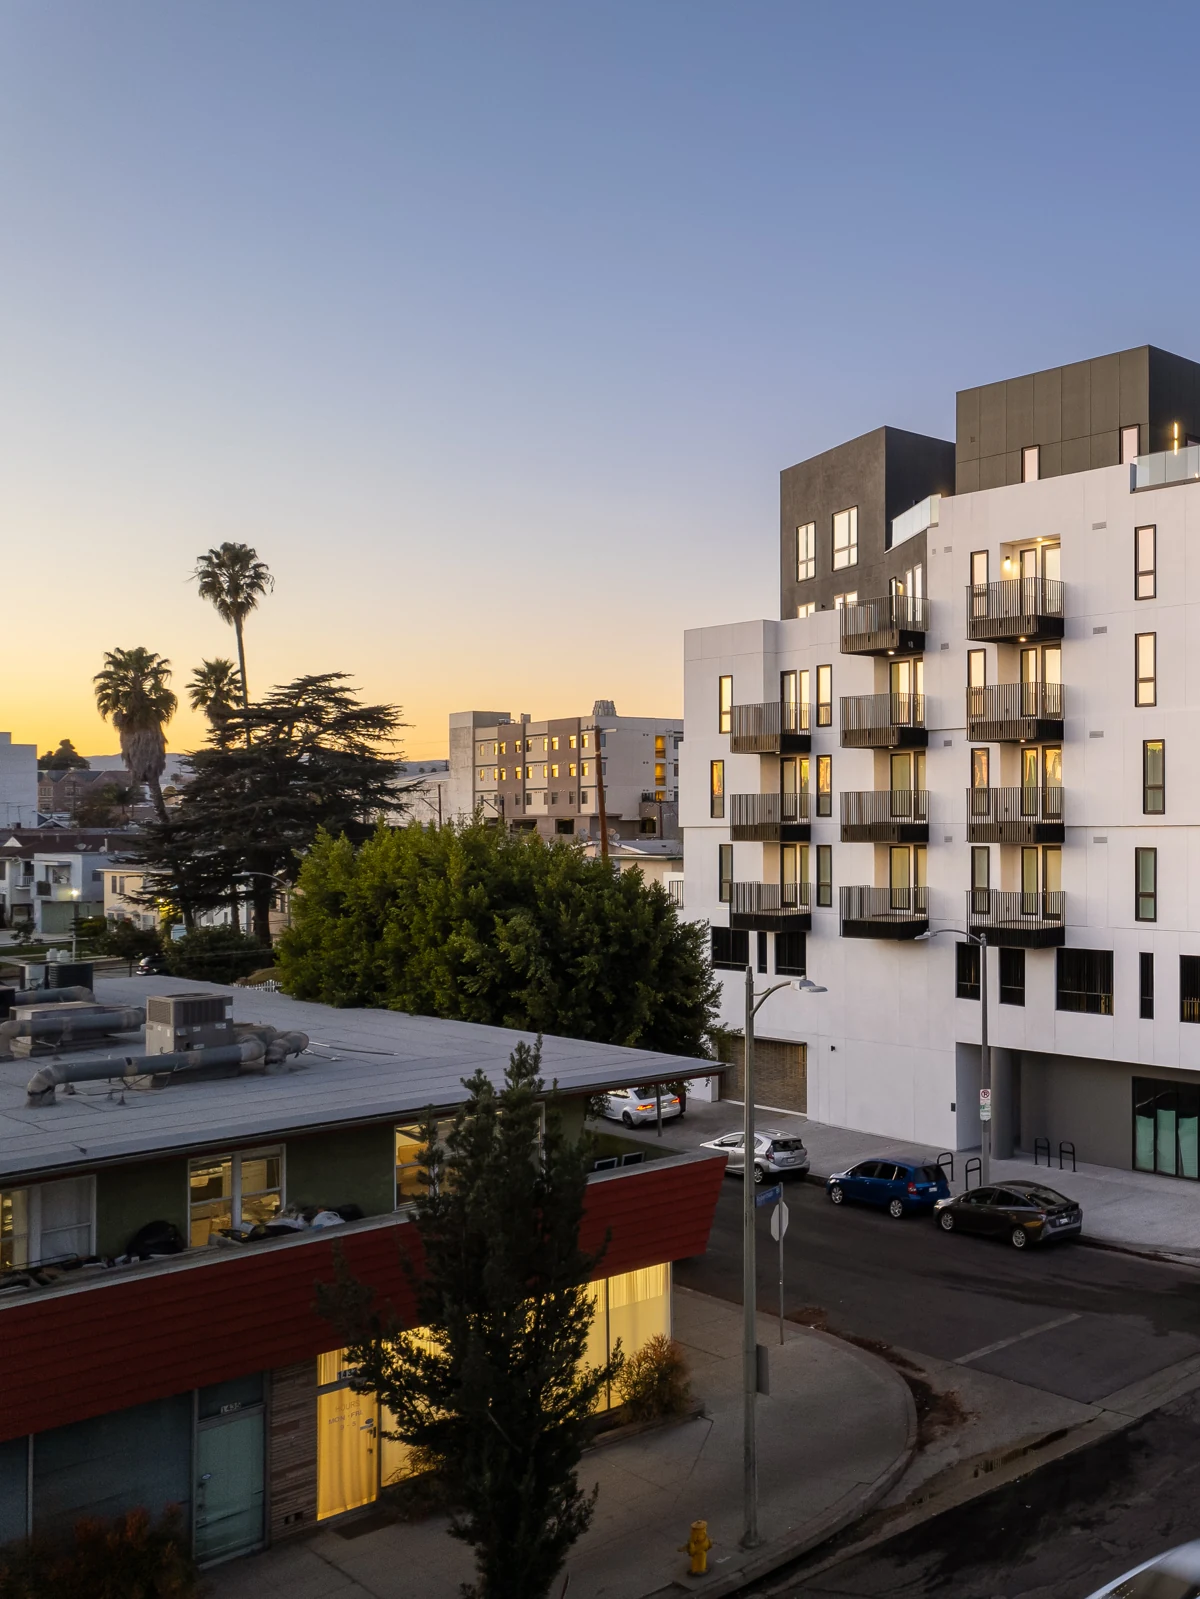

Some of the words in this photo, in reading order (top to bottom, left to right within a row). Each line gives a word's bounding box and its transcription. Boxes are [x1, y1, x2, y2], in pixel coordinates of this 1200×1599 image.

[335, 1399, 360, 1411] HOURS
[328, 1415, 346, 1425] MON
[350, 1410, 363, 1418] FRI
